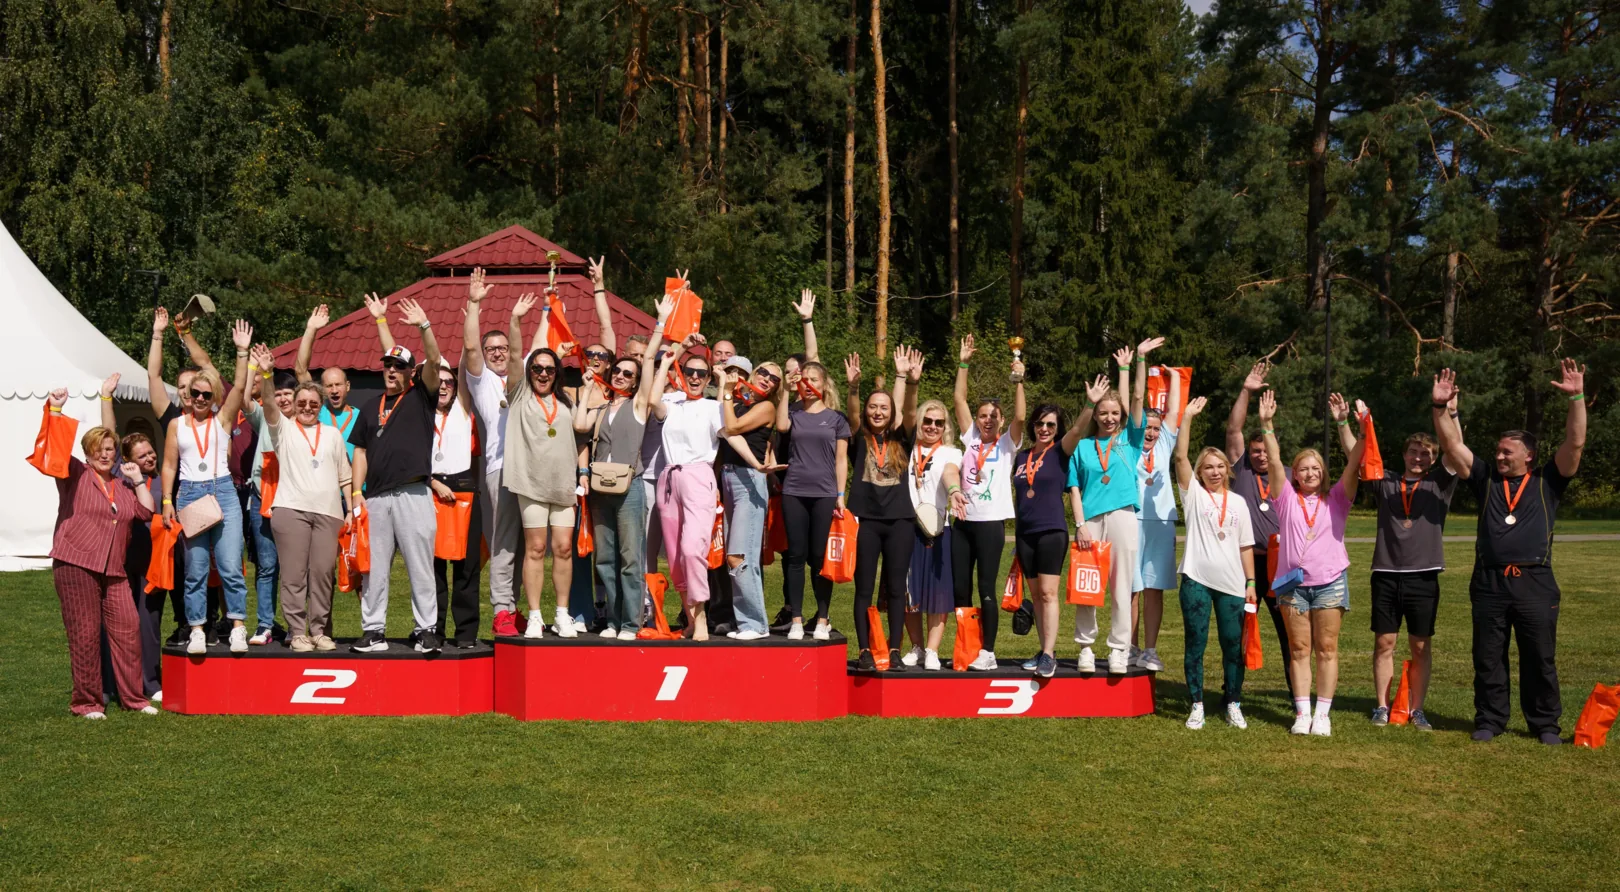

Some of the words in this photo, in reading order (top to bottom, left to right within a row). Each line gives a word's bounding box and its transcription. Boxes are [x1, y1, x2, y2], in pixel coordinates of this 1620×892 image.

[290, 668, 358, 704] 2
[655, 665, 689, 701] 1
[977, 680, 1040, 714] 3
